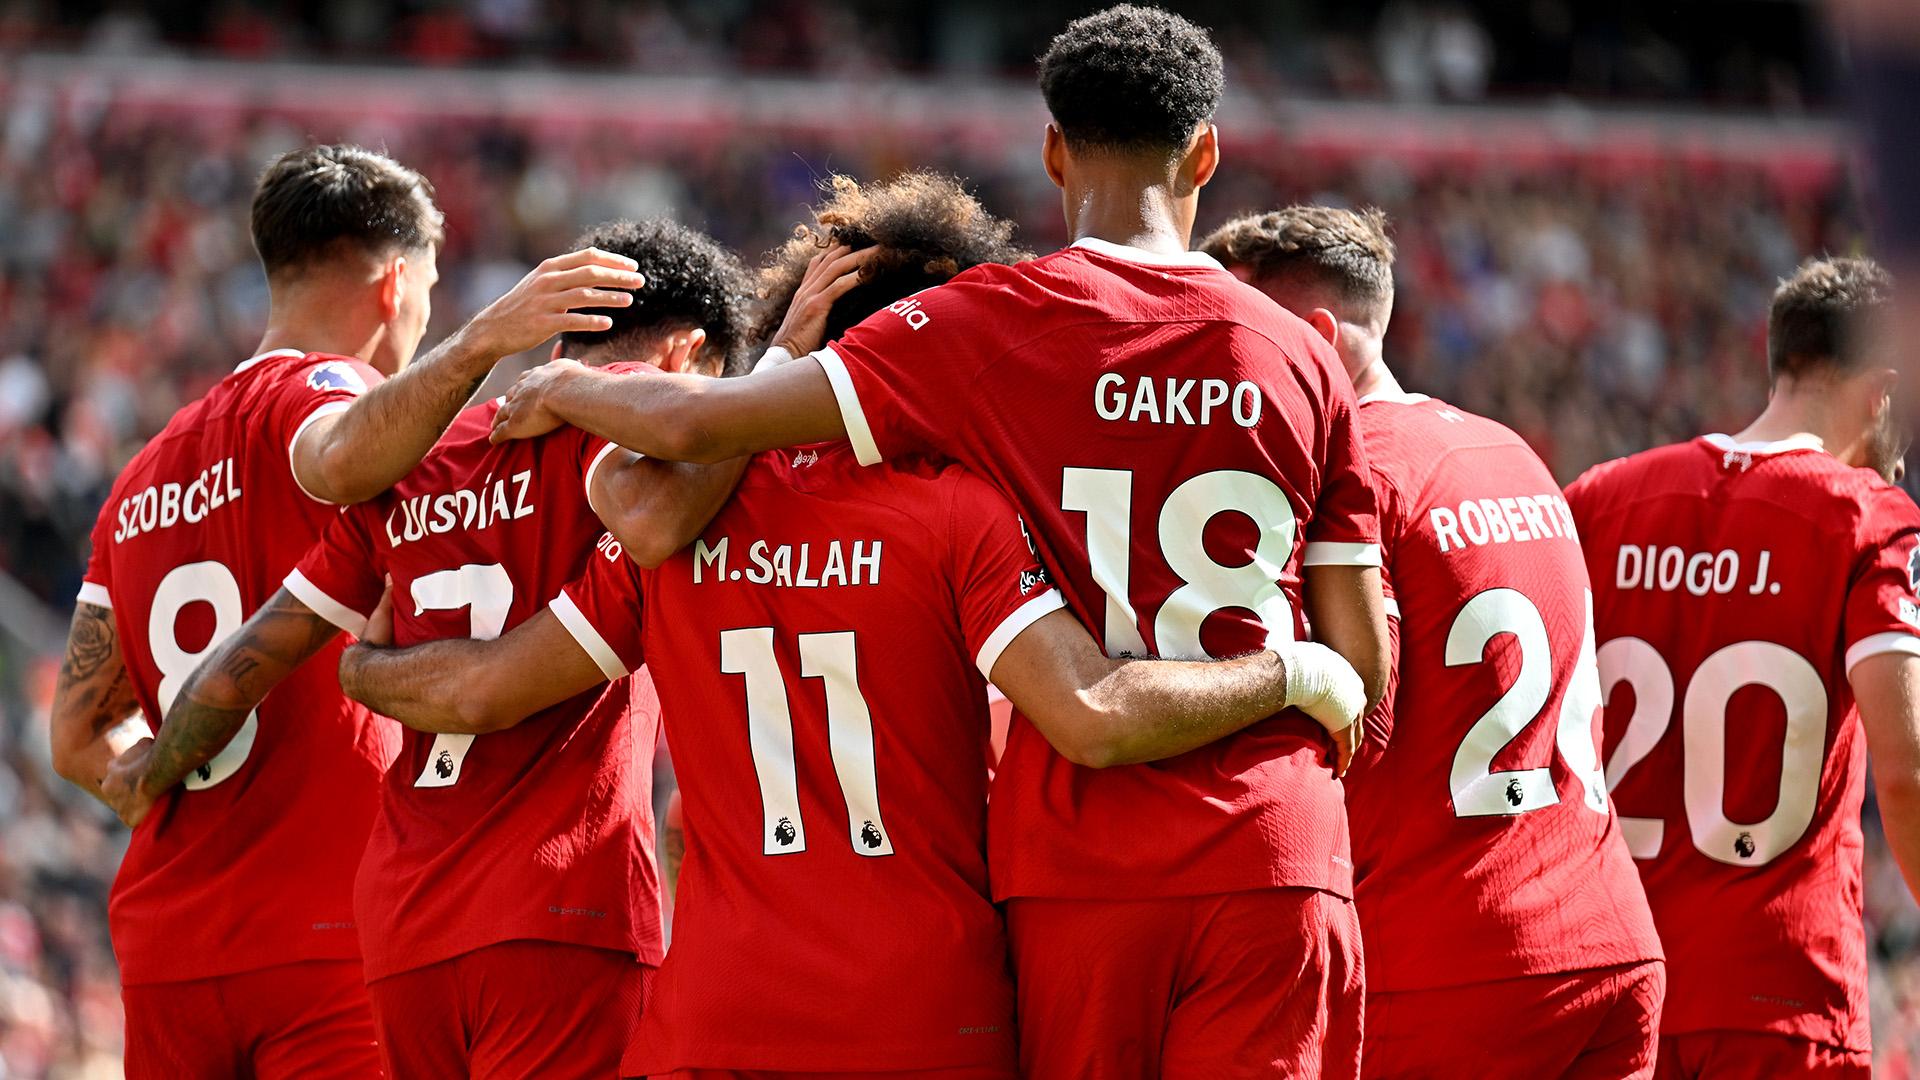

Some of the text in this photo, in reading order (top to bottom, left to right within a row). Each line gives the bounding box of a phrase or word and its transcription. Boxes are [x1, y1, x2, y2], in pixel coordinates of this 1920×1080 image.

[1094, 373, 1262, 428] GAKPO
[693, 537, 882, 588] M.SALAH
[1061, 466, 1297, 661] 18
[1616, 545, 1782, 597] DIOGO J.
[148, 560, 258, 791] 8
[411, 563, 514, 788] 7
[720, 626, 895, 857] 11
[1596, 636, 1828, 867] 20
